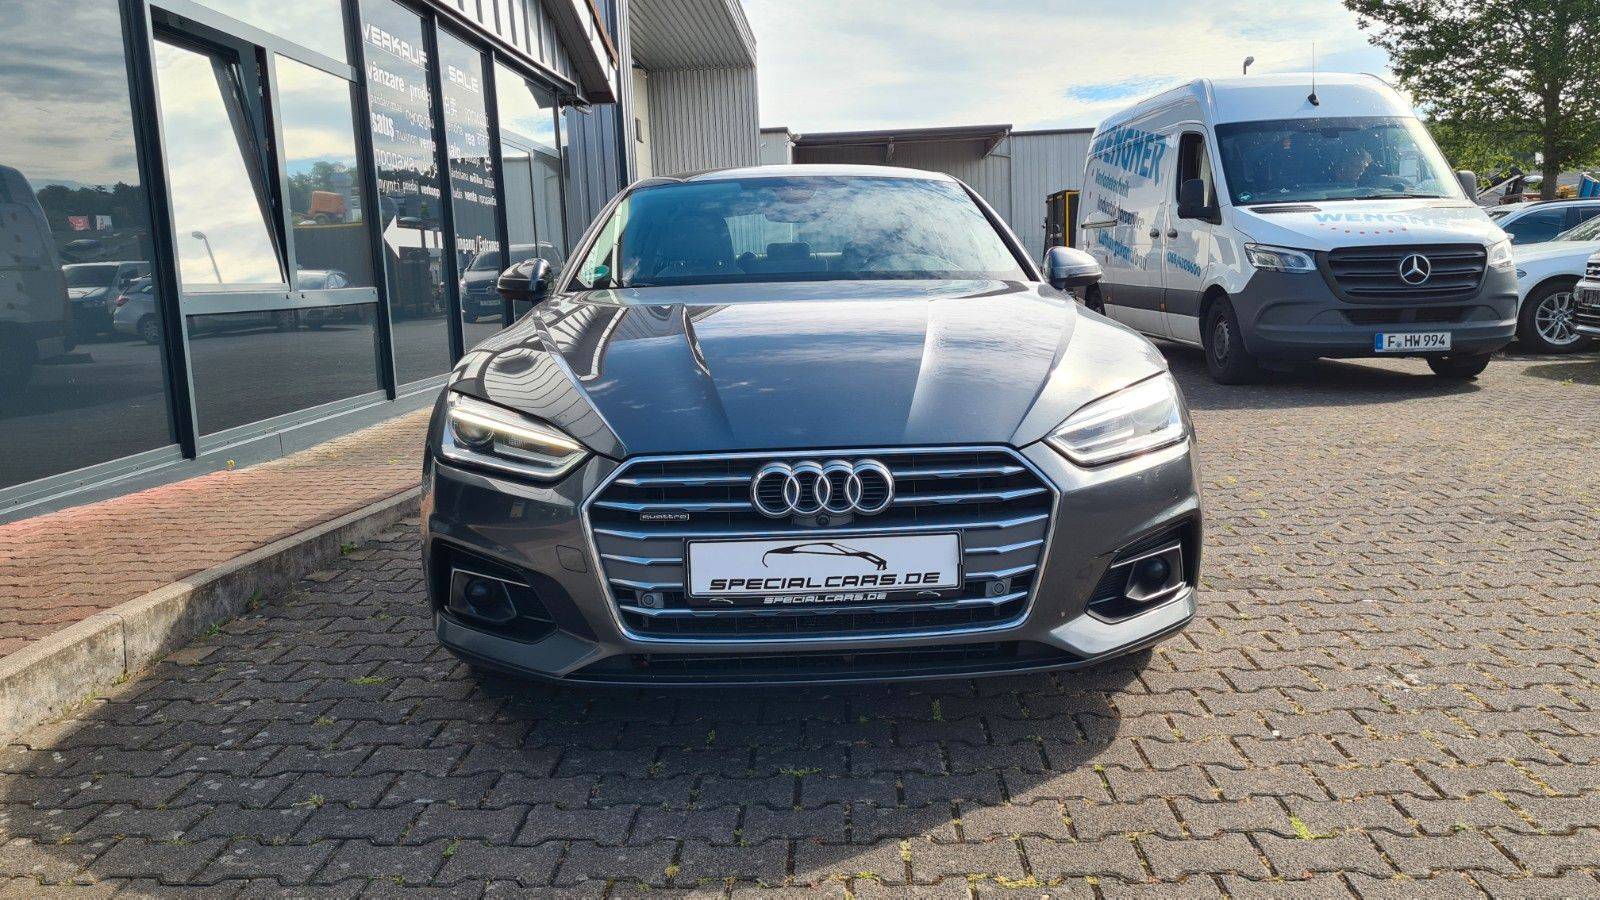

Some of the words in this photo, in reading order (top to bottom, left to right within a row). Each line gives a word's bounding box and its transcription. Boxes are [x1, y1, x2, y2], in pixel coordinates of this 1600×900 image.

[362, 23, 427, 65] VERKAUF
[448, 64, 479, 93] SALE
[1093, 129, 1168, 187] WENGNER
[456, 233, 500, 254] ingang/Entrance
[1388, 335, 1396, 347] F
[1404, 335, 1421, 347] HW
[1423, 334, 1446, 347] 994
[709, 572, 941, 590] SPECIALCARS.DE
[763, 593, 888, 604] SPECIALCARS.DE
